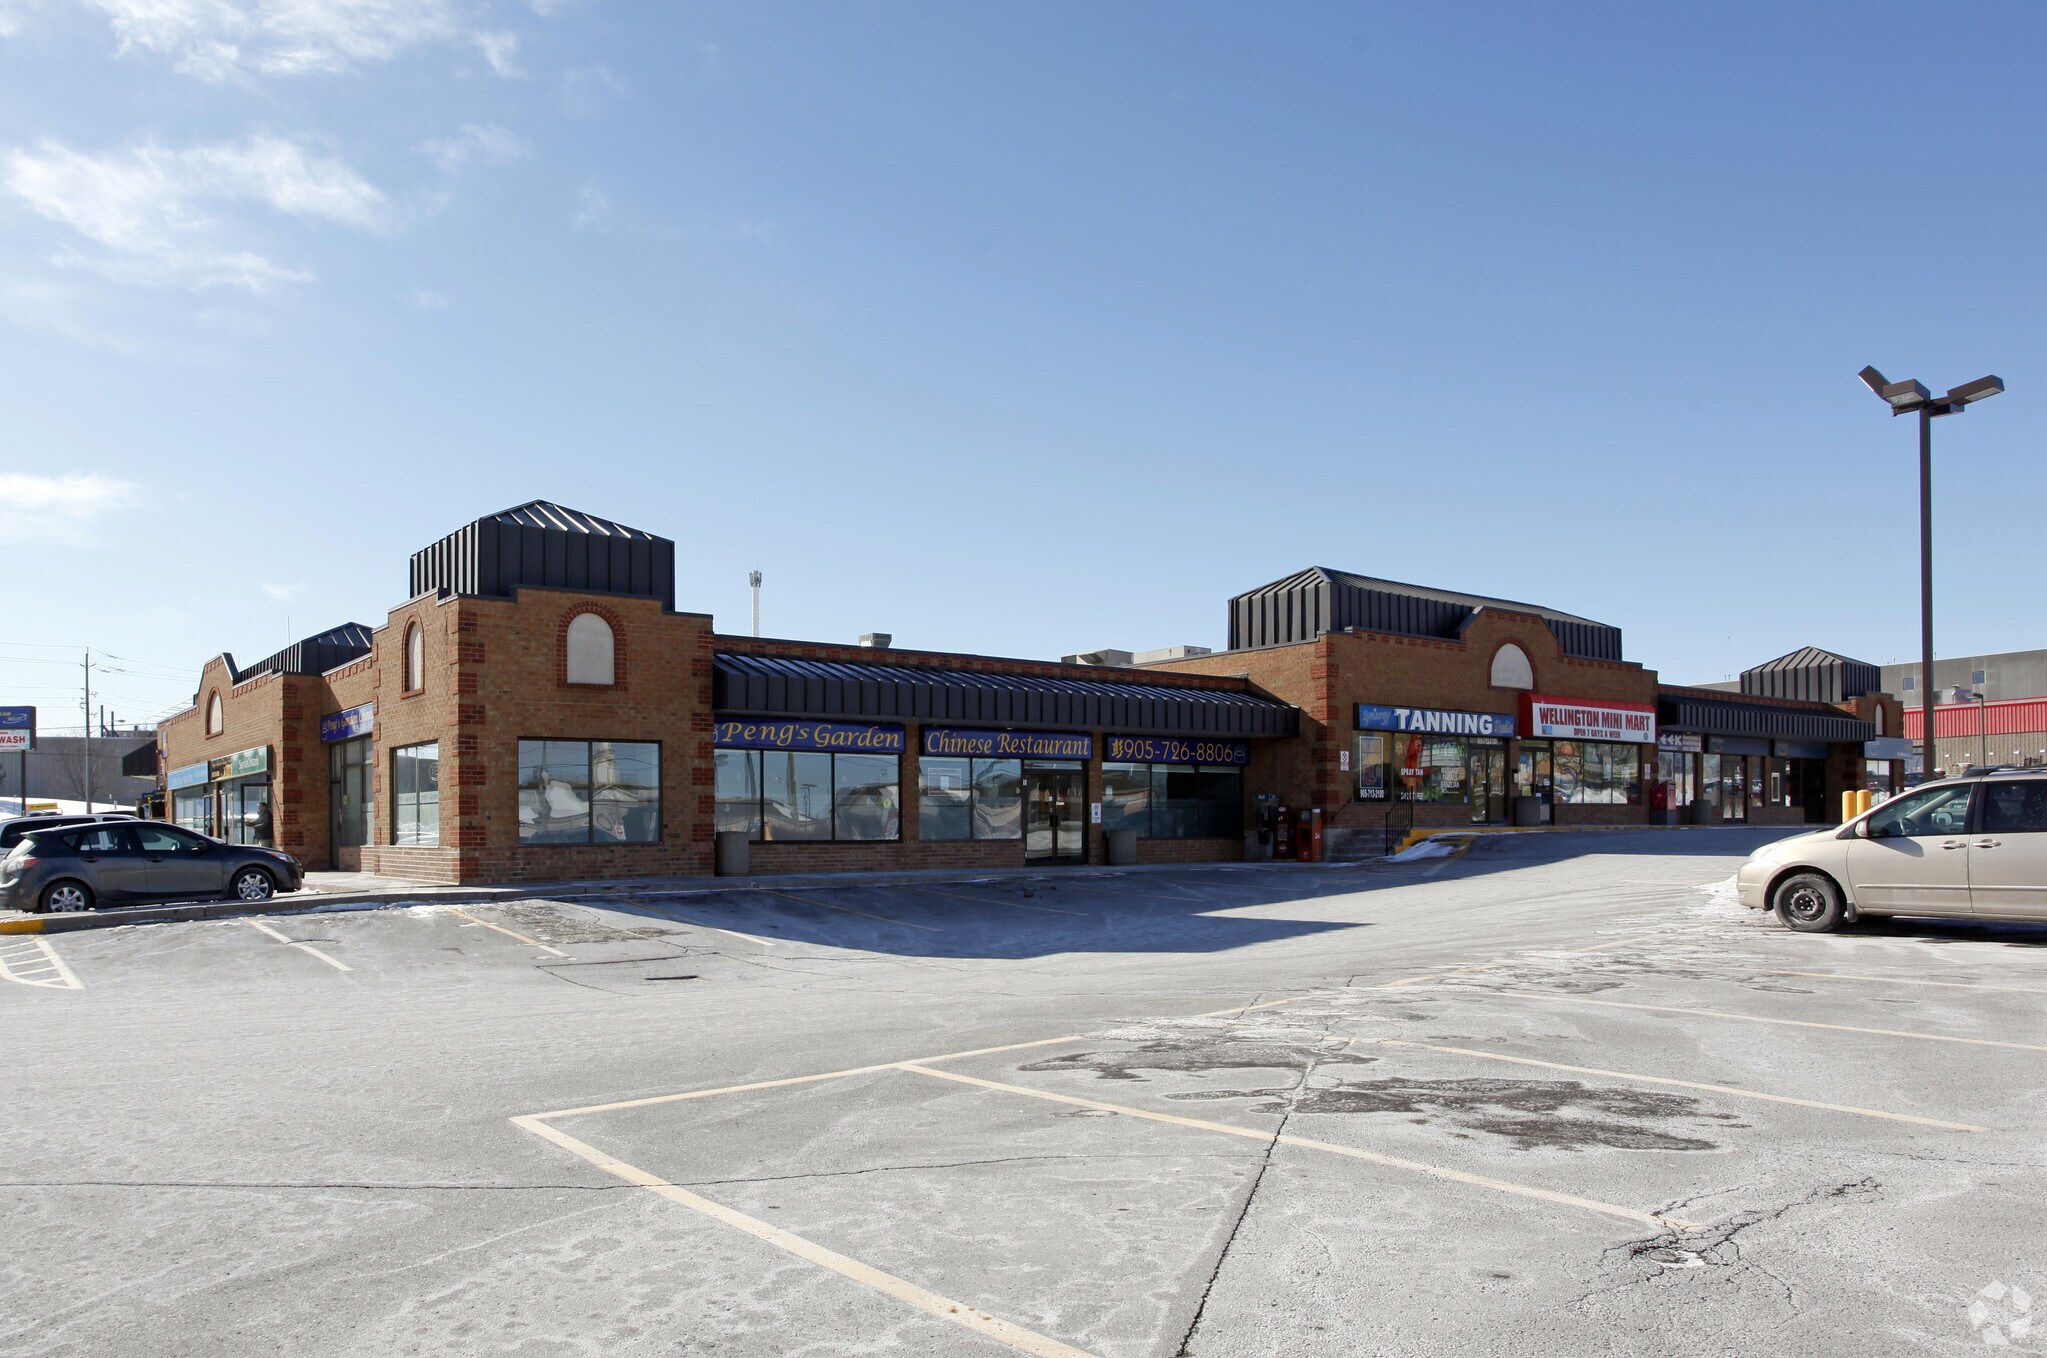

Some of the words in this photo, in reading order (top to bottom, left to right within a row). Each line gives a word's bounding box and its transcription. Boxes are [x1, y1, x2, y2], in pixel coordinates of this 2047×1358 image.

[1394, 708, 1493, 735] TANNING
[1539, 706, 1599, 727] WELLINGTON
[1601, 711, 1622, 730] MINI
[1625, 714, 1650, 732] MART
[721, 722, 810, 747] Peng's
[813, 724, 901, 748] Garden
[927, 731, 992, 755] Chinese
[997, 733, 1090, 756] Restaurant
[1573, 728, 1586, 736] OPEN
[1591, 729, 1604, 738] DAYS
[1609, 730, 1621, 738] WEEK
[1124, 739, 1234, 762] 905-726-8806
[1400, 768, 1414, 776] SPRAY
[1415, 768, 1424, 776] TAN
